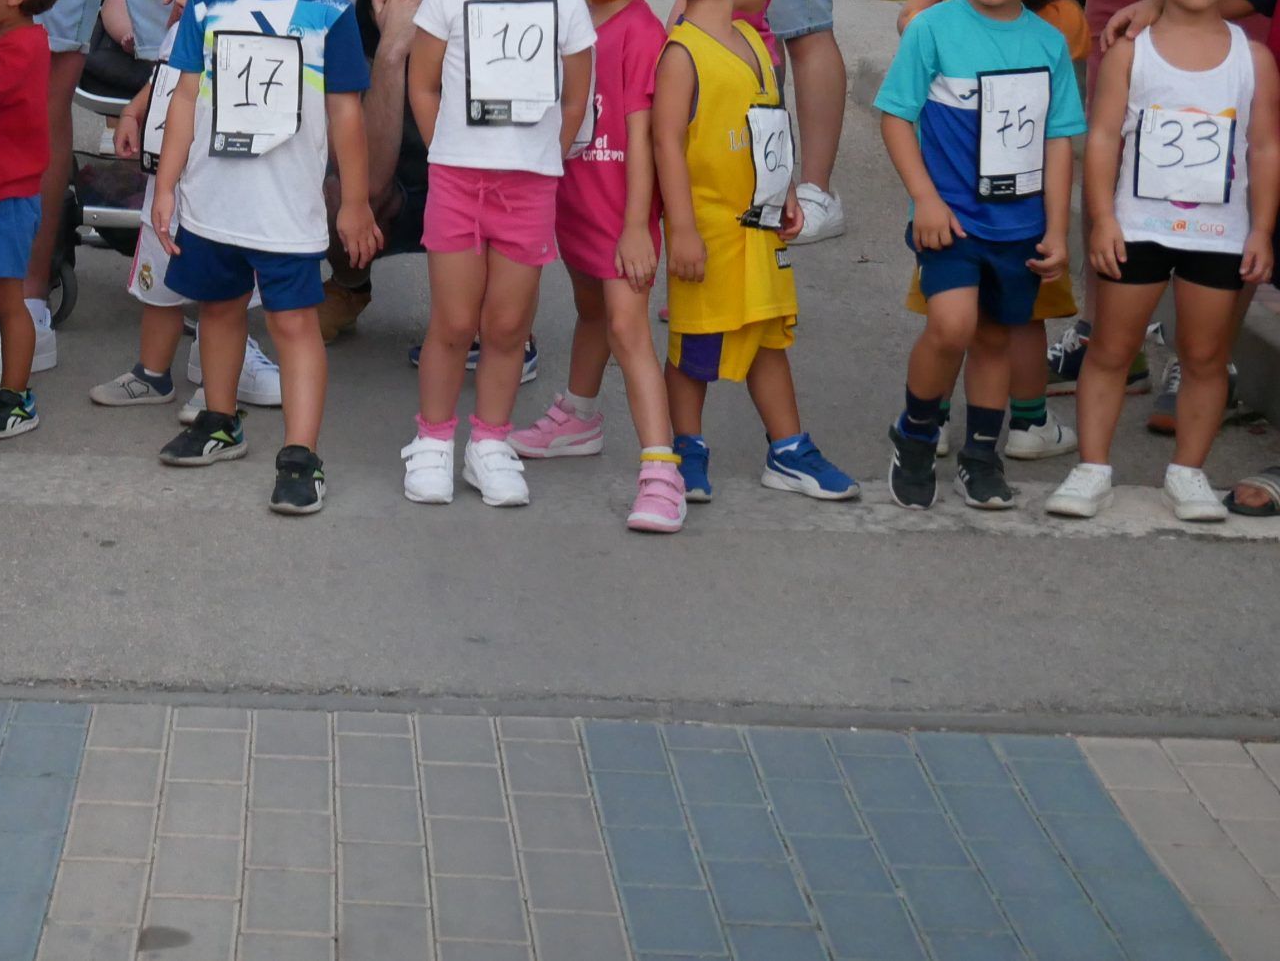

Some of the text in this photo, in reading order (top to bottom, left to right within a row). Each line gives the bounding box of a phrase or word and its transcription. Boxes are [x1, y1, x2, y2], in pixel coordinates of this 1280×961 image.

[486, 22, 544, 65] 10
[233, 55, 284, 108] 17
[595, 133, 608, 149] el
[996, 104, 1036, 150] 75
[1156, 120, 1221, 169] 33
[763, 129, 790, 173] 62
